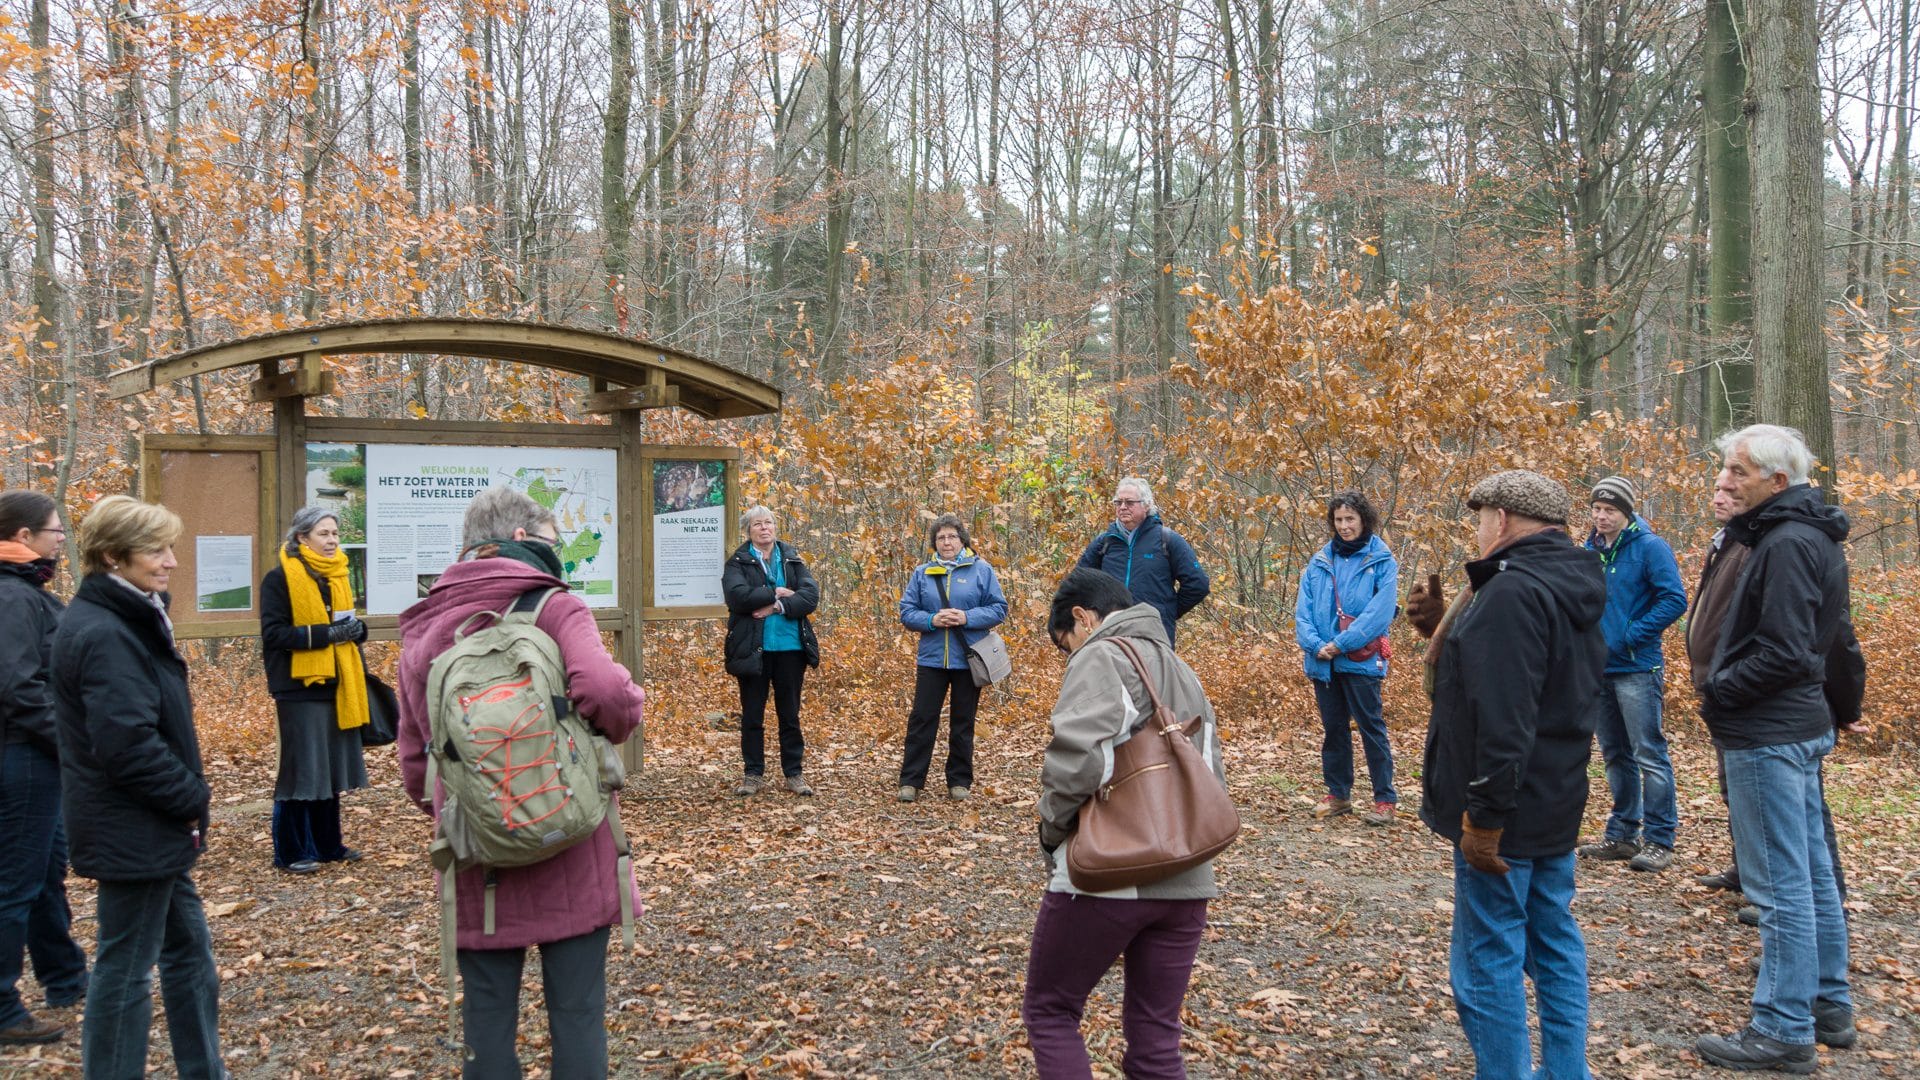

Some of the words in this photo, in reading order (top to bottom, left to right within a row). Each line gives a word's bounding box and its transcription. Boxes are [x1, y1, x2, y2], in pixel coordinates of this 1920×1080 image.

[421, 466, 465, 475] WELKOM
[468, 466, 489, 475] AAN
[378, 477, 401, 486] HET
[404, 477, 433, 486] ZOET
[436, 477, 475, 487] WATER
[477, 477, 489, 487] IN
